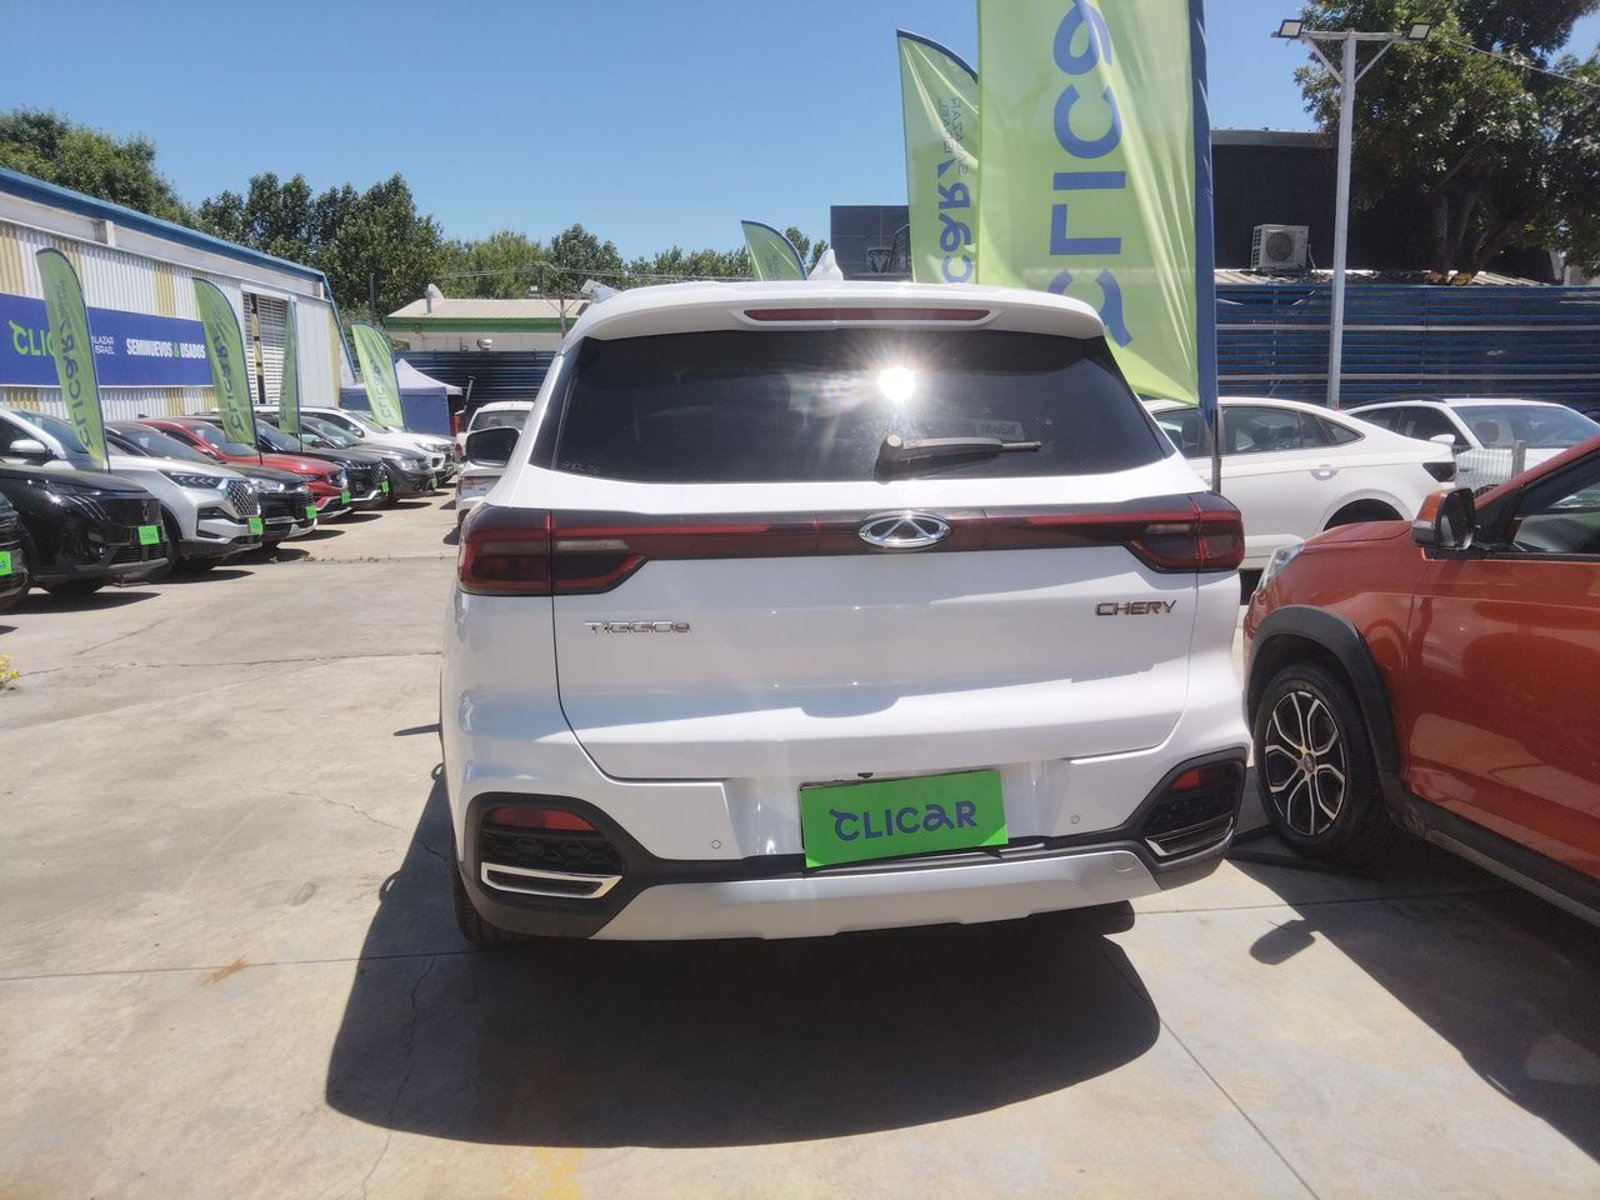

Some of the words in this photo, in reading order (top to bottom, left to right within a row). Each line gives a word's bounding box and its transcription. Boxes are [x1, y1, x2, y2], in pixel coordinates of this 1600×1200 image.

[126, 338, 173, 357] SEMINUEVOS
[180, 342, 206, 359] USADOS
[1096, 599, 1177, 616] CHERY
